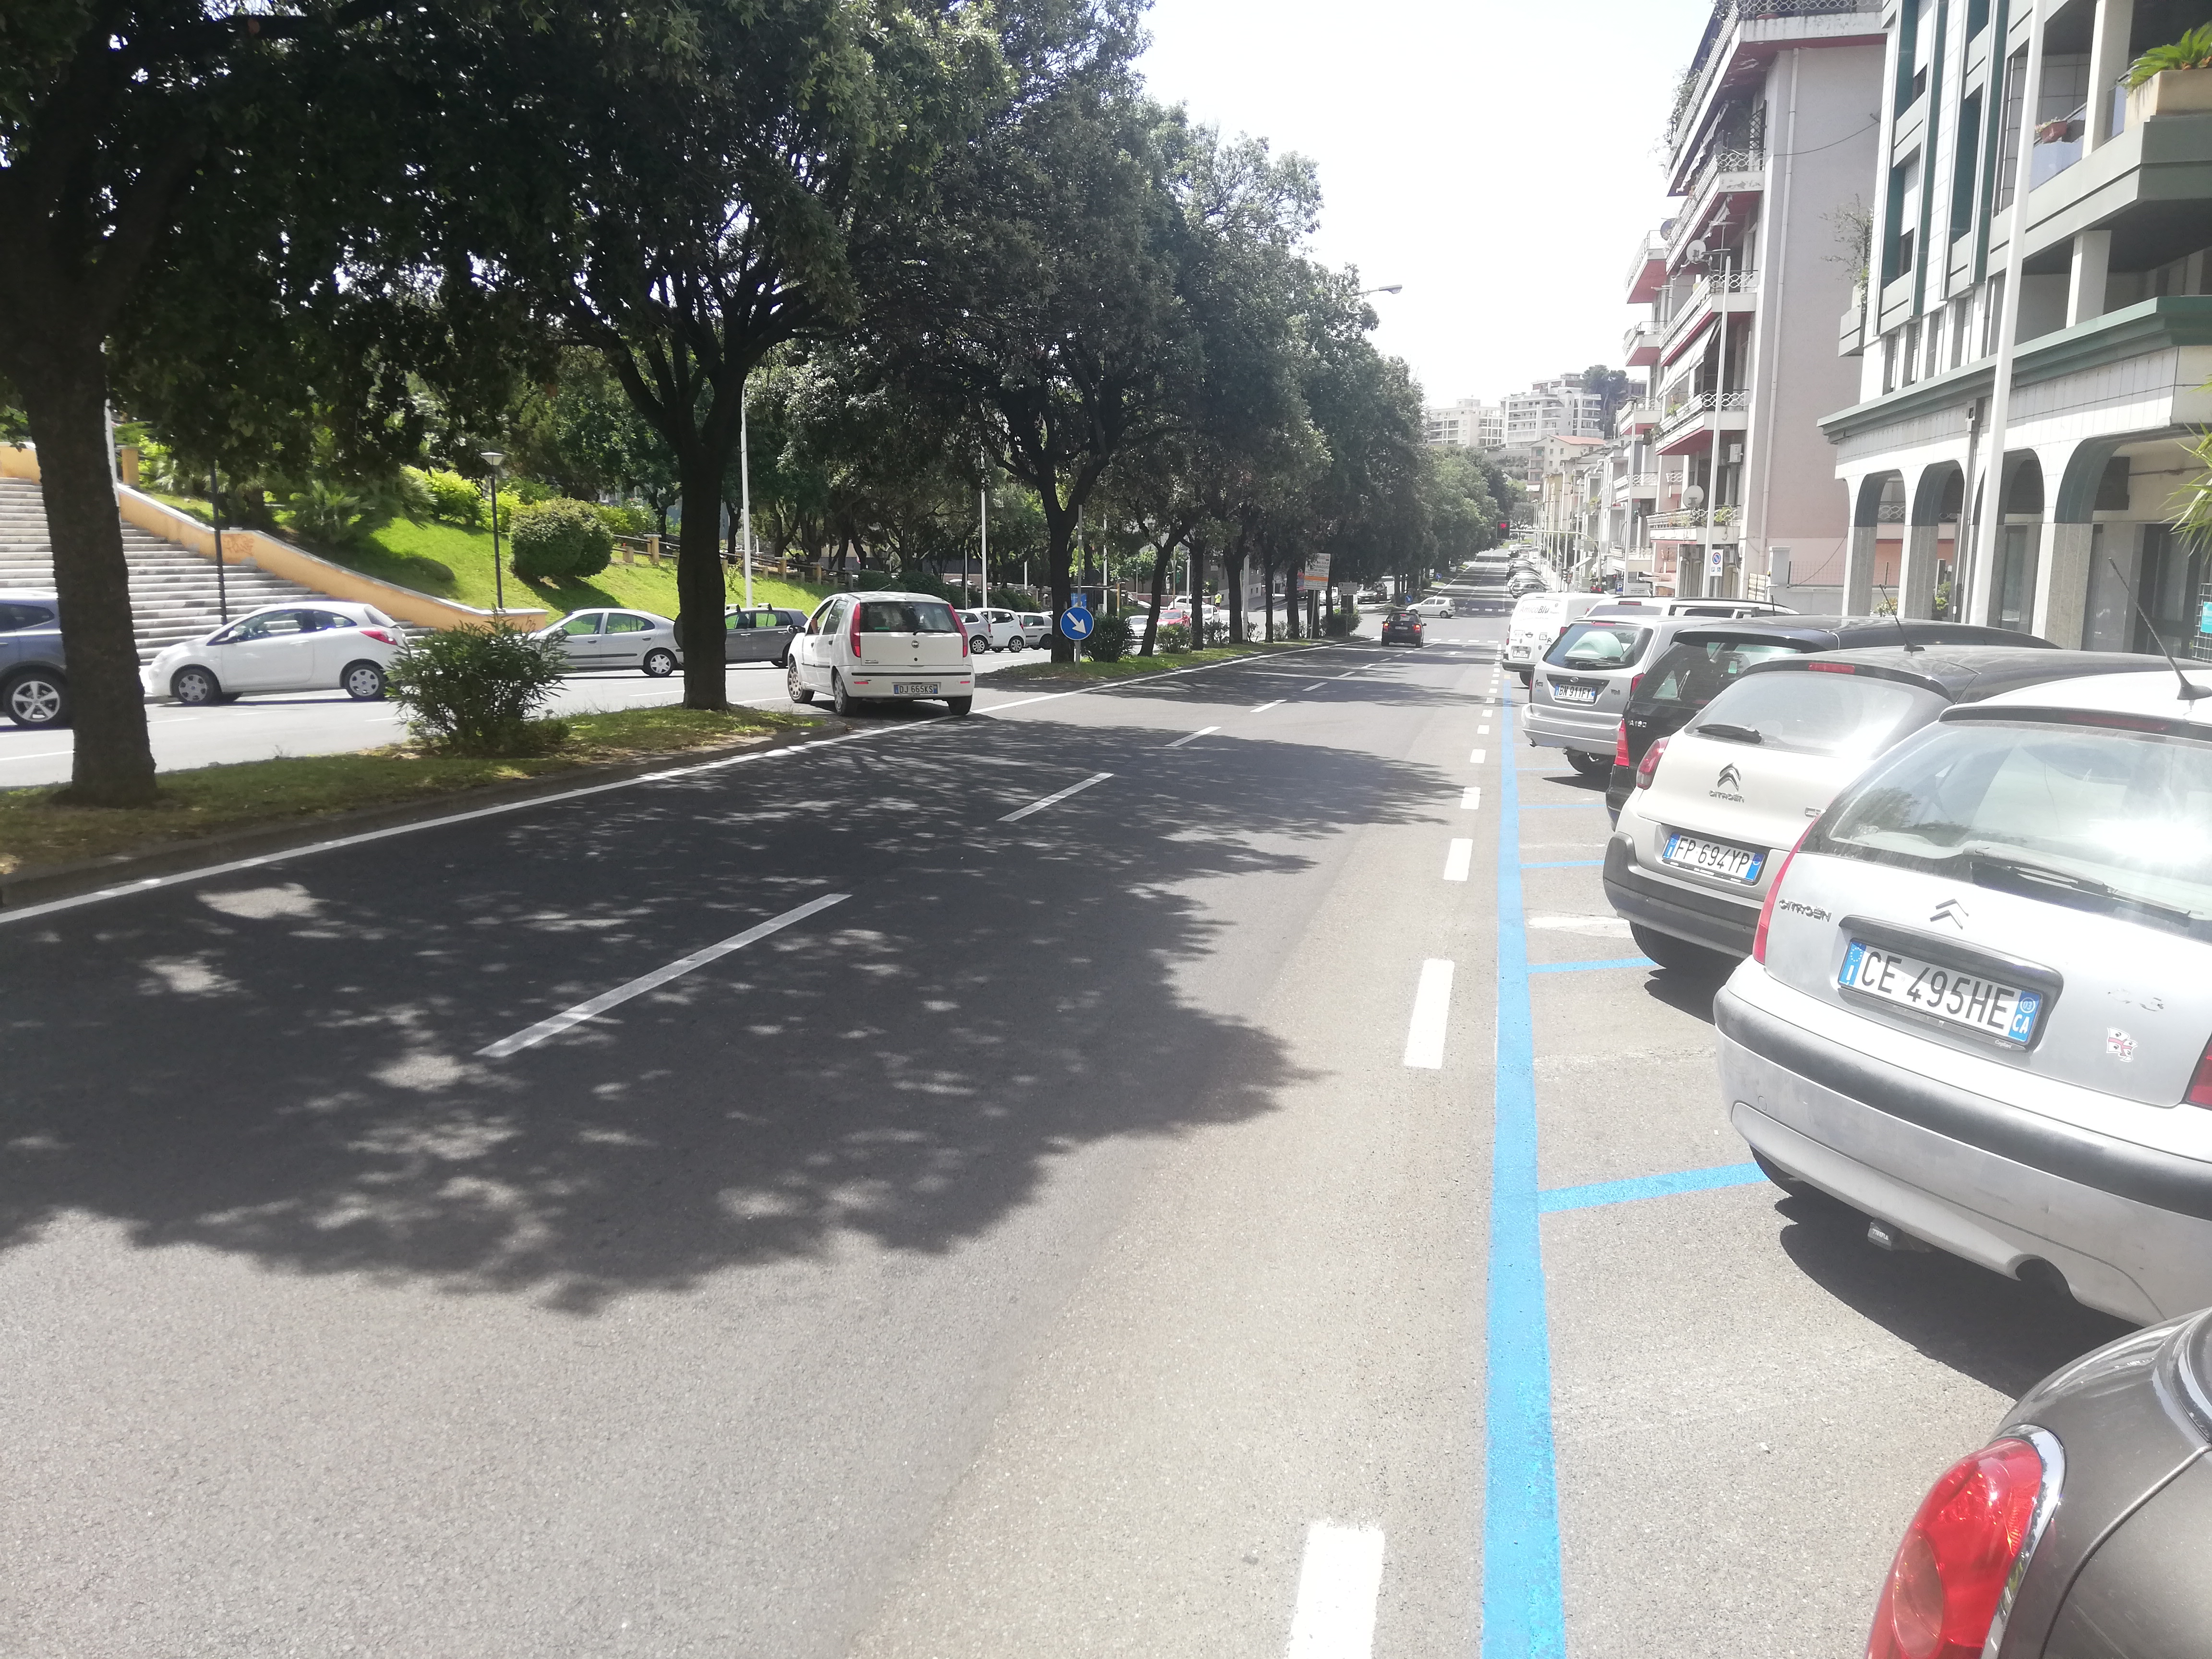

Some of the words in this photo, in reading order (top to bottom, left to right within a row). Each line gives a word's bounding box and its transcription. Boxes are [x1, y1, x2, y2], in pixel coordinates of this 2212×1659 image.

[1674, 838, 1696, 859] FP
[1698, 844, 1750, 873] 694YP
[1862, 951, 1902, 994] CE
[1907, 967, 2015, 1030] 495HE
[2012, 1014, 2030, 1034] CA
